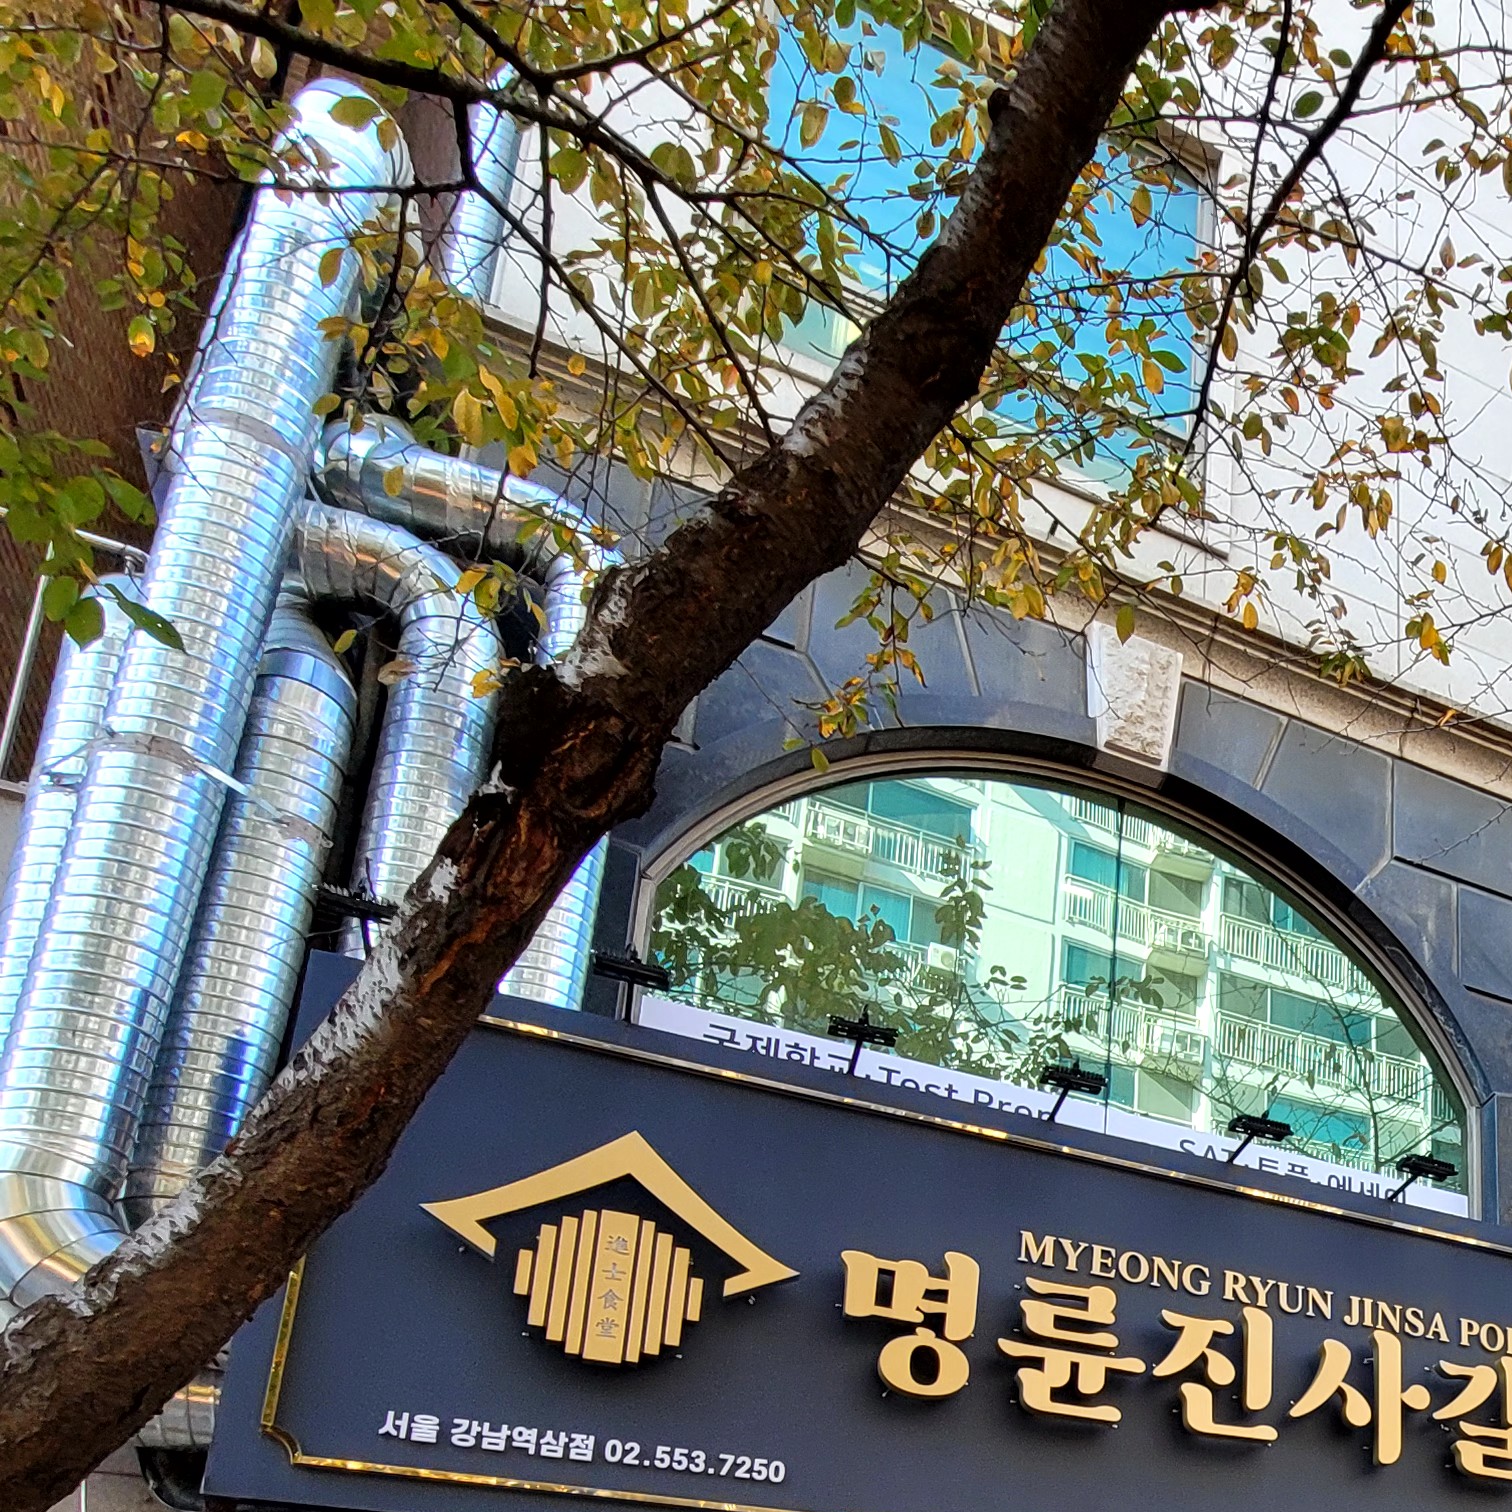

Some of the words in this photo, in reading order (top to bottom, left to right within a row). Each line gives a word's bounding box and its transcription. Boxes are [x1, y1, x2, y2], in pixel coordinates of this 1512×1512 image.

[1017, 1229, 1212, 1297] MYEONG
[1222, 1270, 1334, 1321] RYUN
[1342, 1294, 1450, 1343] JINSA
[378, 1409, 440, 1446] 서울
[450, 1417, 595, 1463] 강남역삼점
[604, 1438, 787, 1485] 02.553.7250
